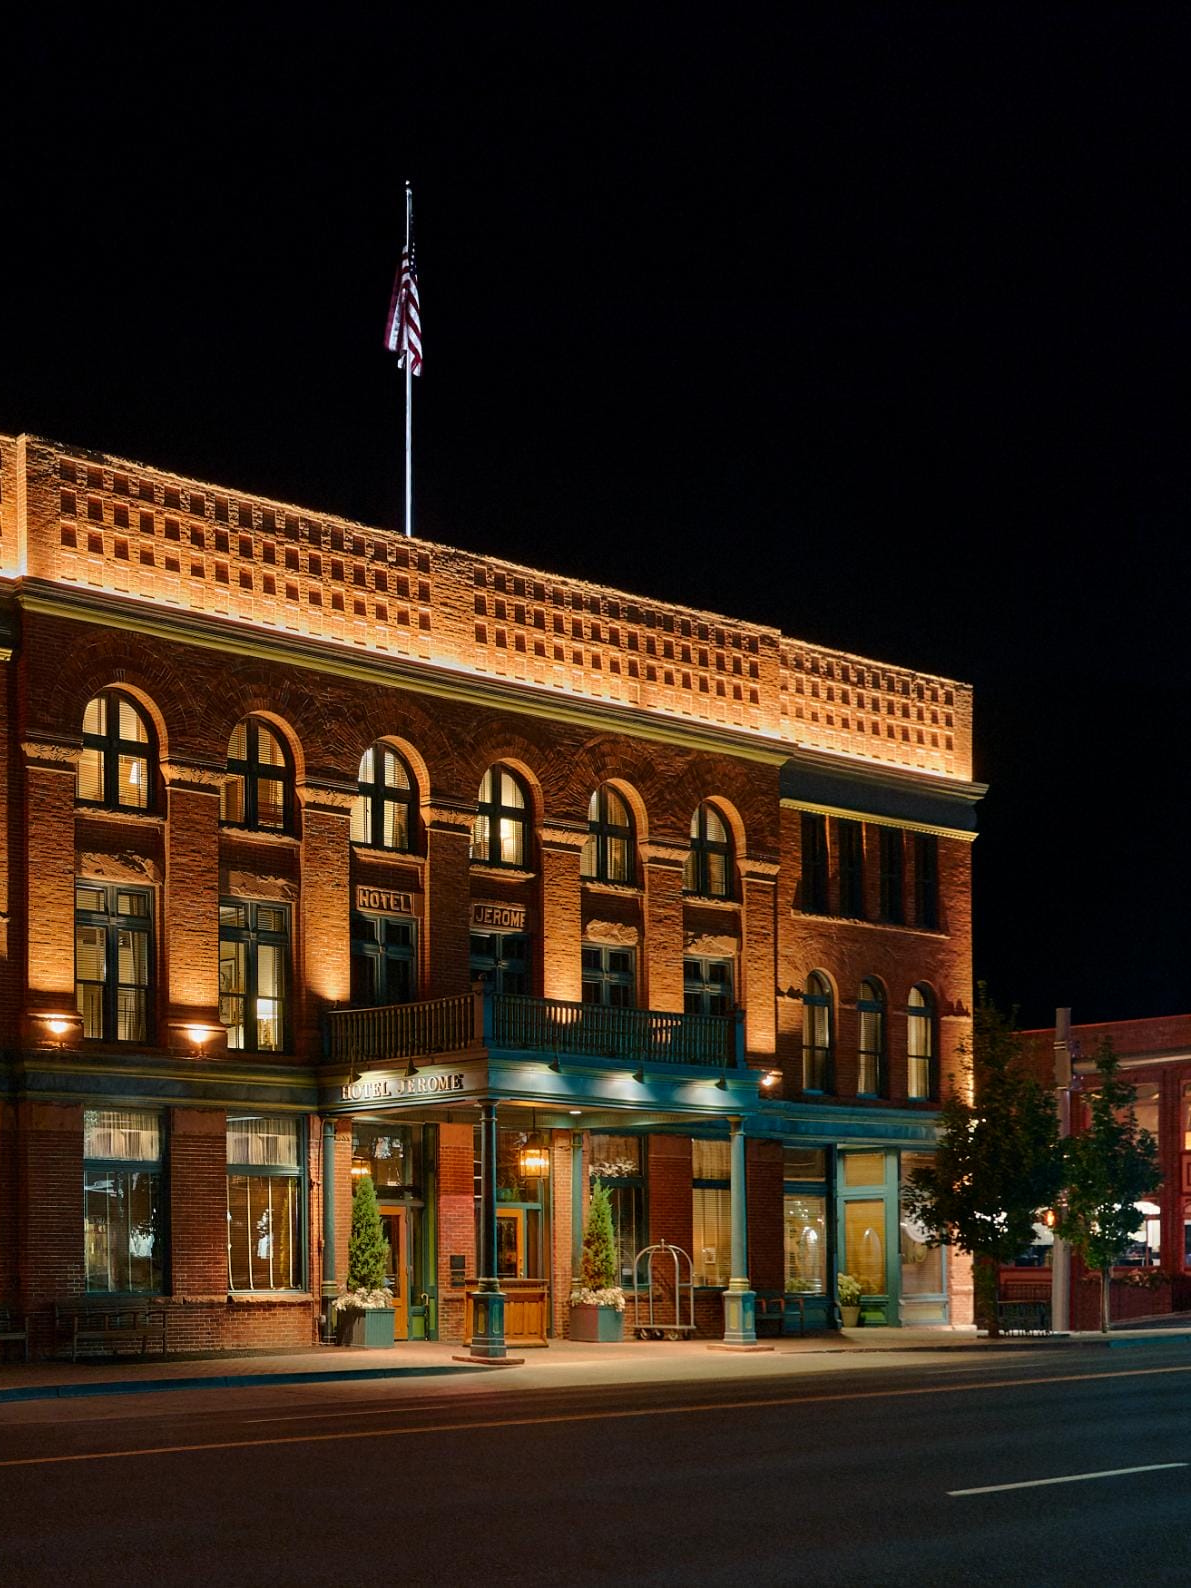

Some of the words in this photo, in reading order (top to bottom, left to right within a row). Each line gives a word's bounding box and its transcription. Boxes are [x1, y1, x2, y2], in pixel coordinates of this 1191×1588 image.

[359, 889, 411, 912] HOTEL
[475, 905, 527, 928] JEROME
[341, 1081, 391, 1101] HOTEL
[396, 1074, 464, 1095] JEROME
